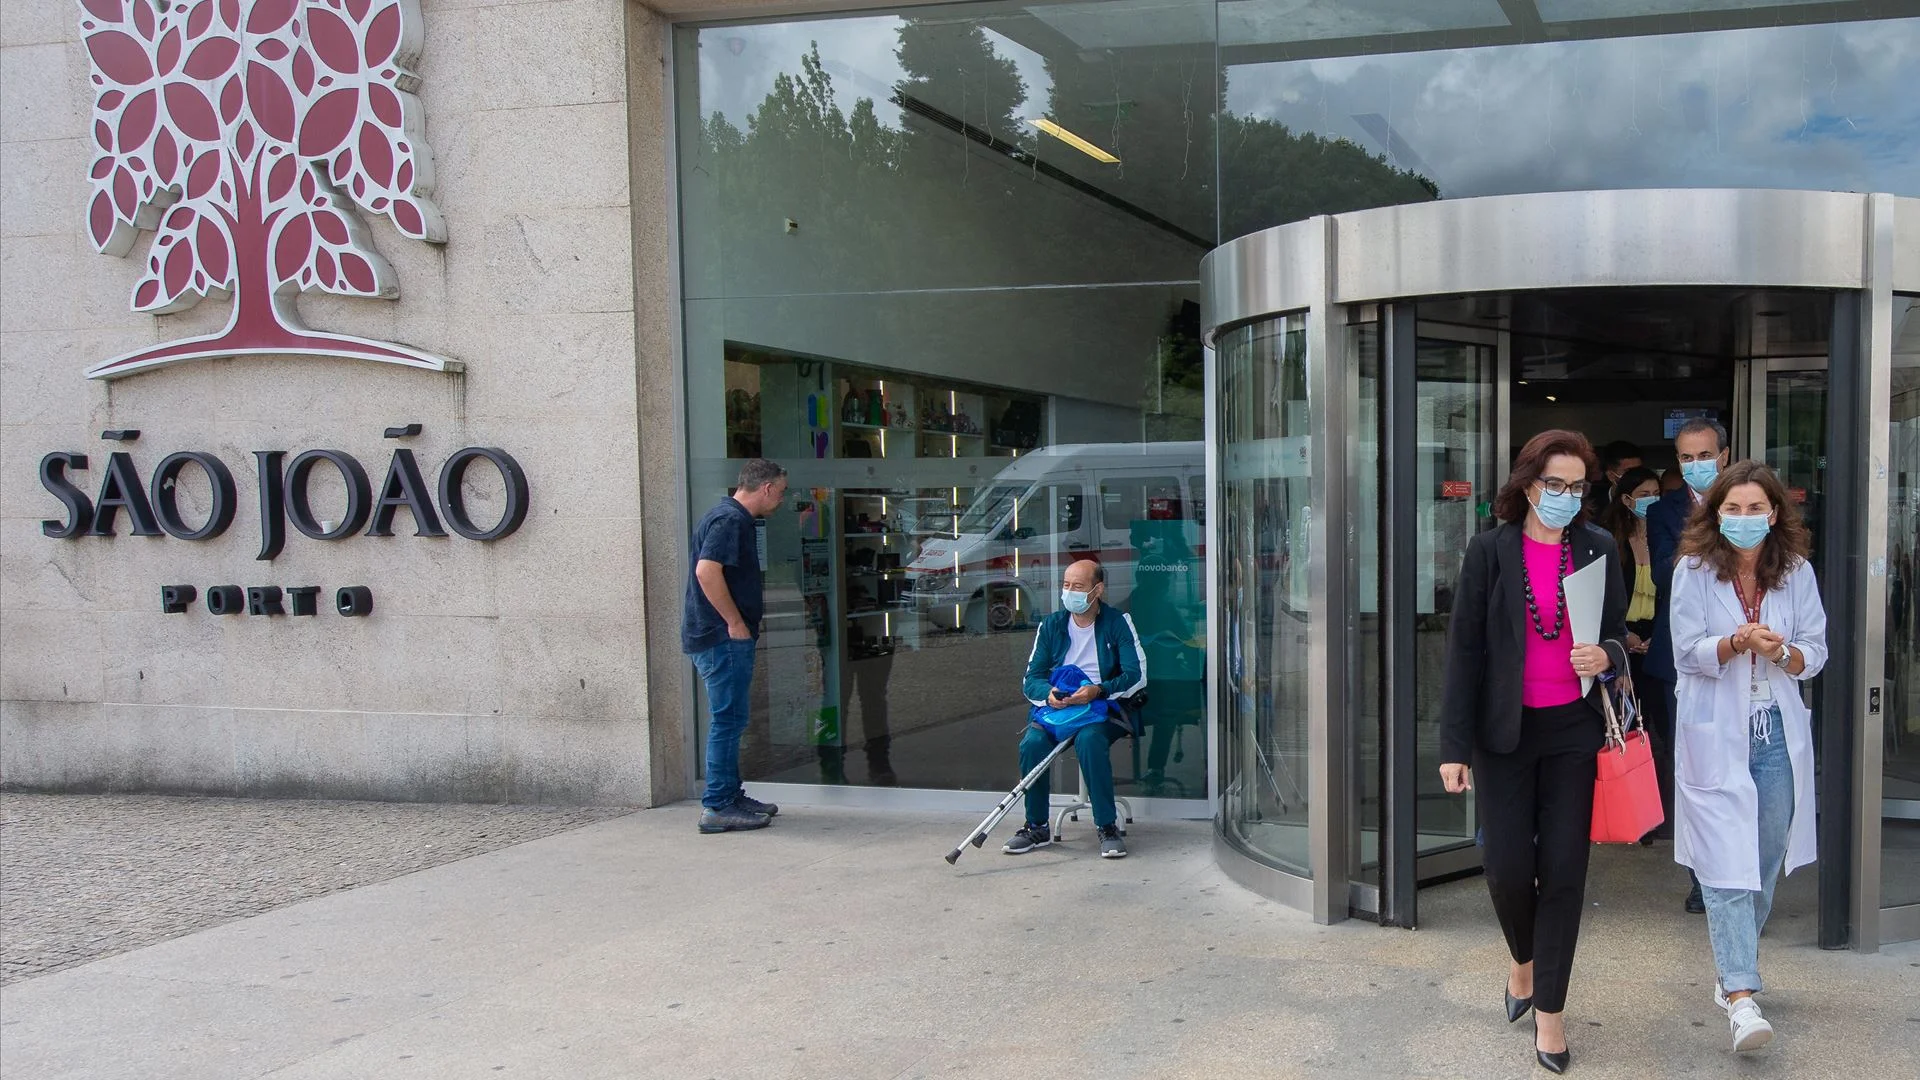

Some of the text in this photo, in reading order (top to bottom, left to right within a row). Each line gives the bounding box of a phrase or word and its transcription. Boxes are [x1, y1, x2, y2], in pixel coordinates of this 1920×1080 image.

[40, 424, 530, 560] SÃO JOÃO
[1138, 563, 1188, 572] novobanco
[161, 585, 373, 617] PORTO
